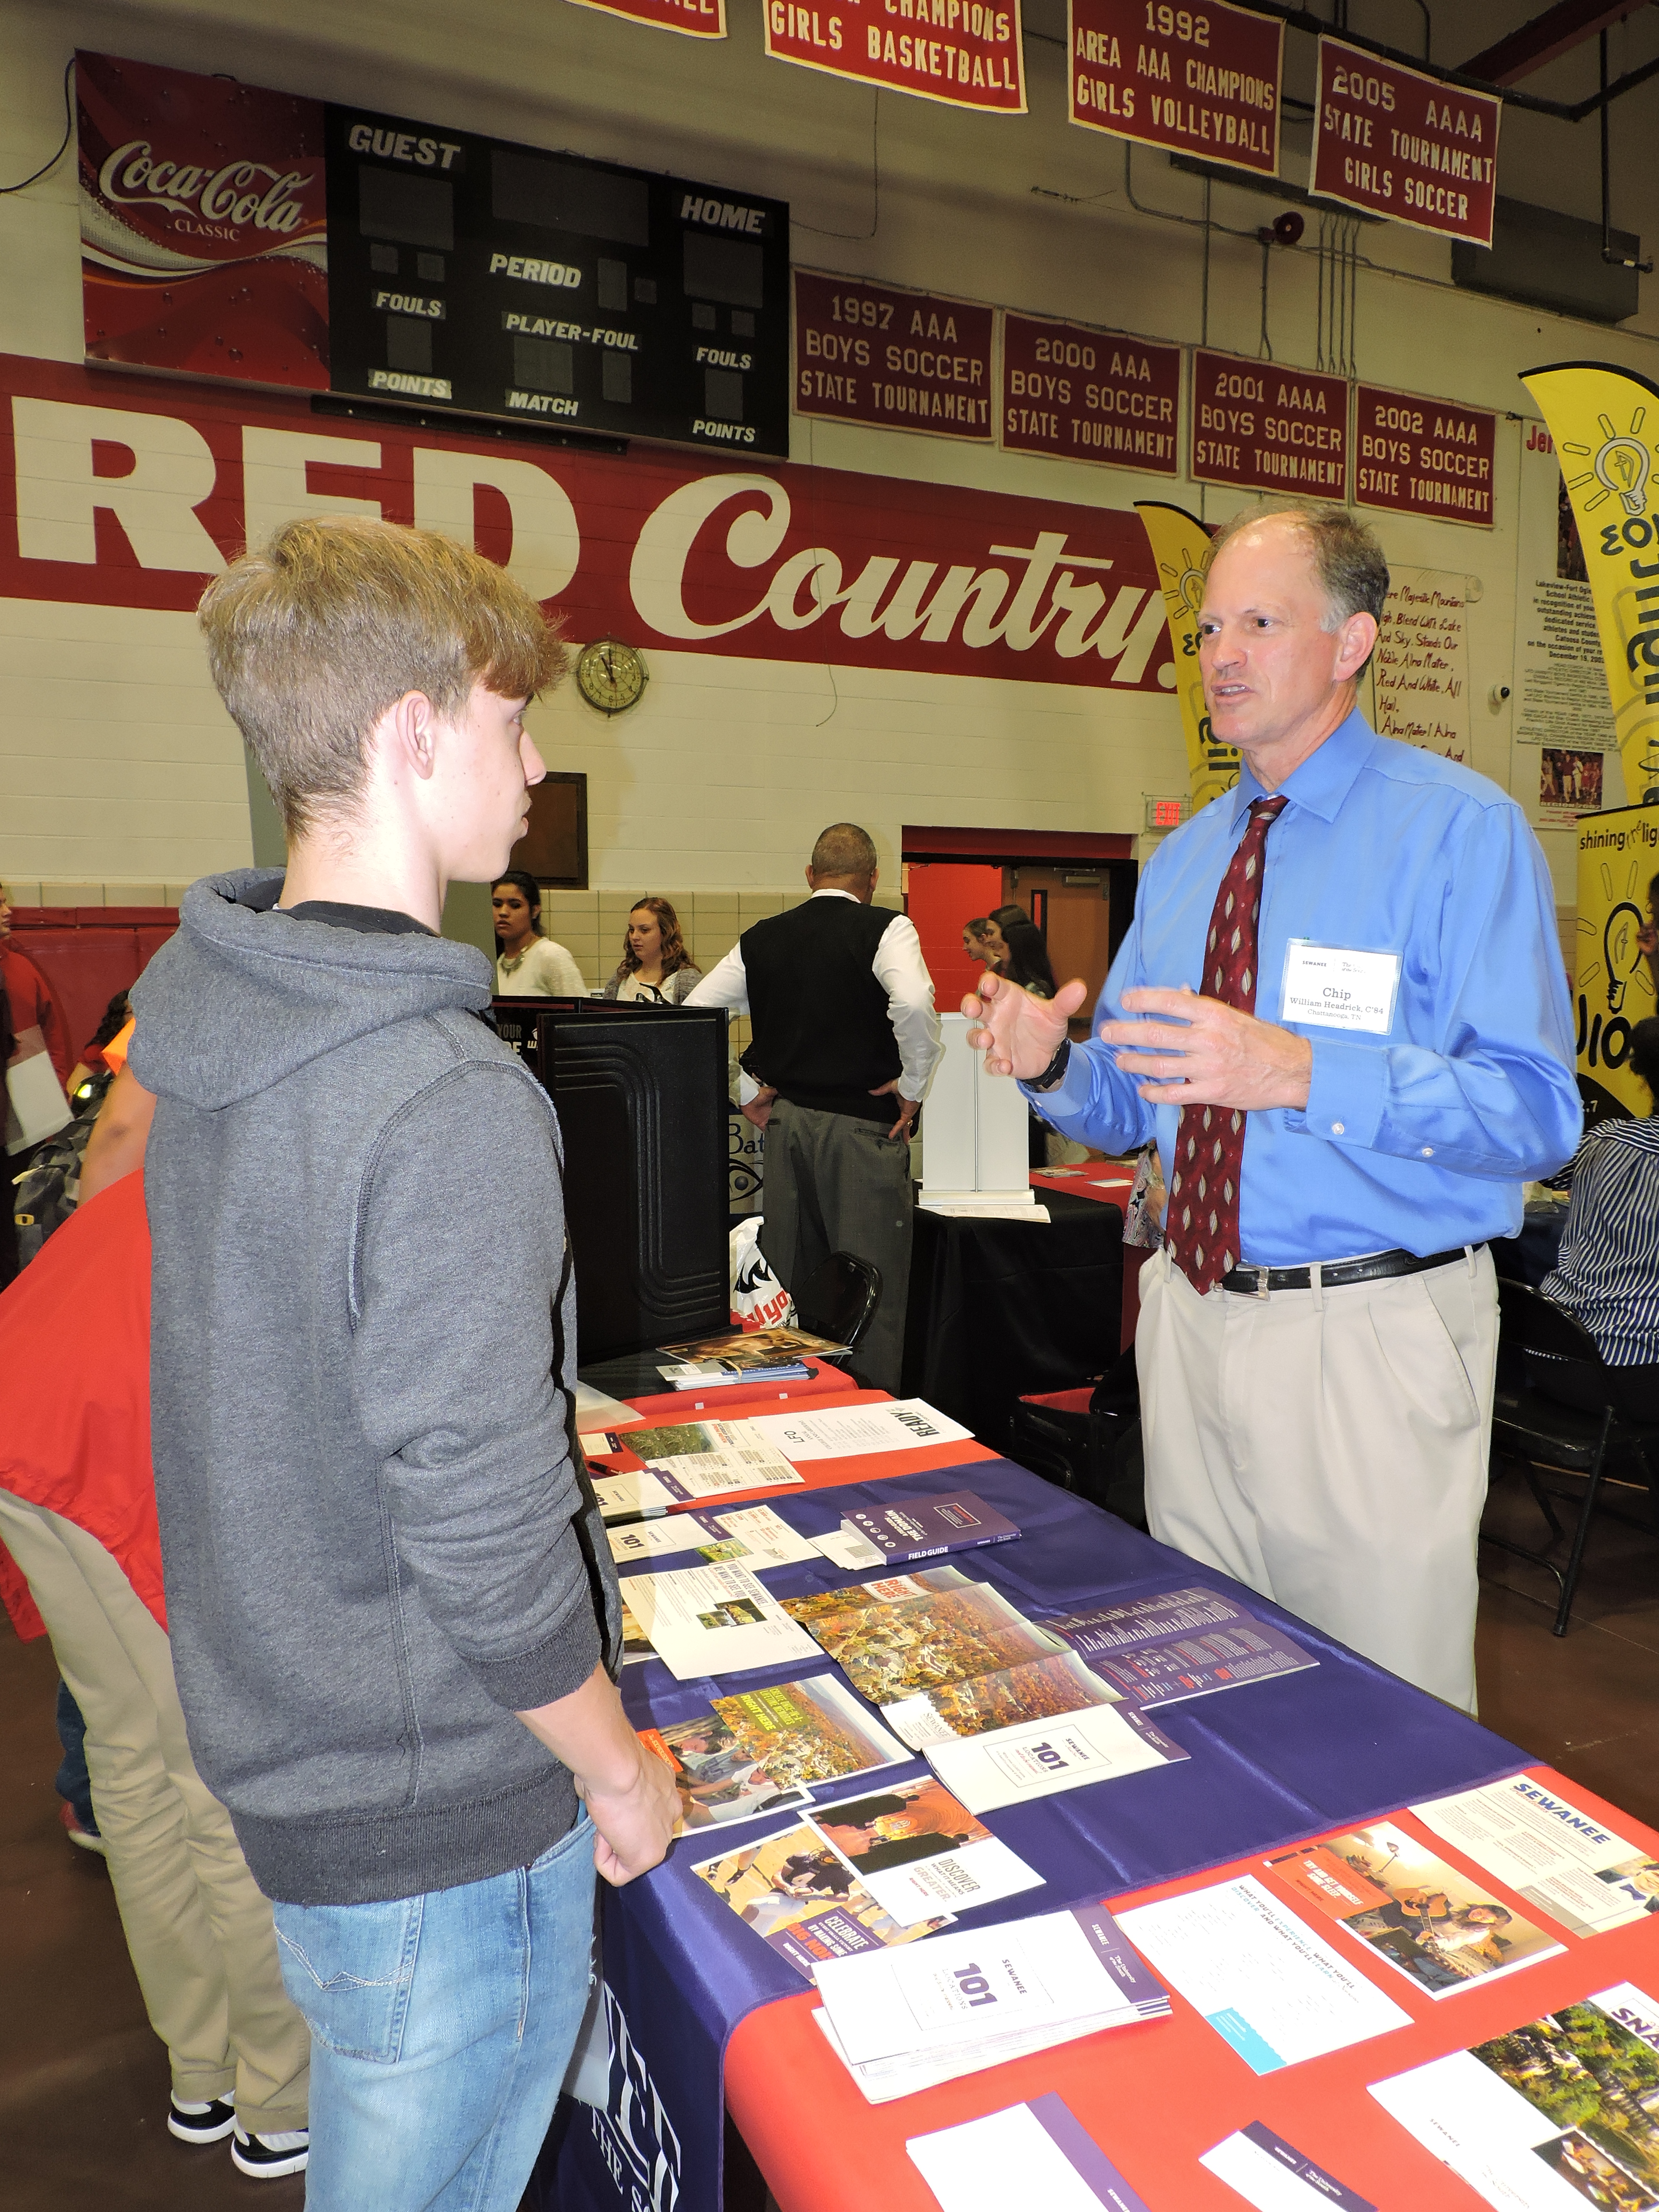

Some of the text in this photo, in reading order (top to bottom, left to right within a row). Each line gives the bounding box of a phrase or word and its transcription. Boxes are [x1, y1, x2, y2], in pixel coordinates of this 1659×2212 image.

[885, 0, 1010, 41] CHAMPIONS
[1145, 1, 1210, 48] 1992
[771, 3, 1016, 90] GIRLS BASKETBALL
[1077, 27, 1274, 111] AREA AAA CHAMPIONS
[1077, 74, 1270, 155] GIRLS VOLLEYBALL
[1333, 65, 1482, 142] 2005 AAAA
[349, 124, 461, 169] GUEST
[1325, 104, 1493, 183] STATE TOURNAMENT
[98, 139, 315, 233] Coca-Cola
[1345, 157, 1468, 221] GIRLS SOCCER
[174, 218, 240, 242] CLASSIC
[680, 195, 766, 234] HOME
[490, 253, 582, 289] PERIOD
[376, 292, 441, 318] FOULS
[832, 295, 958, 343] 1997 AAA
[506, 313, 639, 351] PLAYER-FOUL
[696, 346, 752, 370] FOULS
[805, 328, 984, 386] BOYS SOCCER
[1035, 337, 1151, 382] 2000 AAA
[373, 371, 448, 398] POINTS
[801, 370, 988, 424] STATE TOURNAMENT
[1011, 370, 1173, 423] BOYS SOCCER
[1214, 372, 1327, 415] 2001 AAAA
[509, 392, 578, 417] MATCH
[692, 419, 756, 443] POINTS
[1007, 408, 1174, 460] STATE TOURNAMENT
[1201, 403, 1342, 452] BOYS SOCCER
[1375, 405, 1478, 446] 2002 AAAA
[1196, 441, 1344, 487] STATE TOURNAMENT
[1361, 435, 1490, 480] BOYS SOCCER
[1359, 468, 1489, 513] STATE TOURNAMENT
[1546, 590, 1566, 598] School
[1396, 613, 1420, 626] Blend
[1537, 607, 1572, 618] outstanding
[1544, 616, 1574, 625] dedicated
[1416, 632, 1441, 649] Stands
[1444, 636, 1458, 650] Our
[1555, 635, 1579, 643] Catoosa
[1549, 651, 1578, 660] December
[1376, 669, 1395, 687] Red
[1396, 673, 1417, 690] And
[1155, 801, 1181, 826] EXIT
[1580, 829, 1626, 851] shining
[1289, 997, 1384, 1014] William Headrick, C'84
[1322, 987, 1351, 1000] Chip
[1307, 1009, 1349, 1020] Chattanooga,
[496, 1023, 522, 1039] YOUR
[784, 1431, 805, 1443] LFO
[890, 1412, 941, 1437] READY
[885, 1510, 914, 1530] DOMAIN
[620, 1534, 645, 1550] 101
[648, 1530, 661, 1543] SEWANEE
[908, 1546, 949, 1560] FIELD GUIDE
[717, 1571, 733, 1580] WANT
[731, 1569, 747, 1579] WANT
[884, 1579, 918, 1597] RIGHT
[870, 1582, 902, 1599] HERE
[759, 1690, 780, 1707] LIFETIME
[773, 1706, 795, 1725] MEMORIES
[769, 1688, 787, 1702] CREATE
[740, 1695, 763, 1713] RIGHT
[755, 1713, 777, 1731] HERE
[923, 1712, 951, 1737] SEWANEE
[1022, 1746, 1048, 1773] LOCATIONS
[1031, 1742, 1070, 1770] 101
[1066, 1738, 1090, 1761] SEWANEE
[1513, 1783, 1611, 1844] SEWANEE
[931, 1863, 946, 1876] WHAT
[947, 1879, 965, 1895] MEANS
[938, 1858, 981, 1892] DISCOVER
[785, 1922, 811, 1941] BIG
[807, 1923, 848, 1957] BY MAKING SOME
[824, 1915, 869, 1950] CELEBRATE
[1231, 1887, 1334, 1979] DISCOVER AND WHAT YOU'LL LEARN
[1238, 1884, 1355, 1989] WHAT YOU'LL EXPERIENCE WHAT YOU'LL
[953, 1962, 998, 2007] 101
[1001, 1959, 1028, 1995] SEWANEE
[1429, 2117, 1461, 2148] SEWANEE
